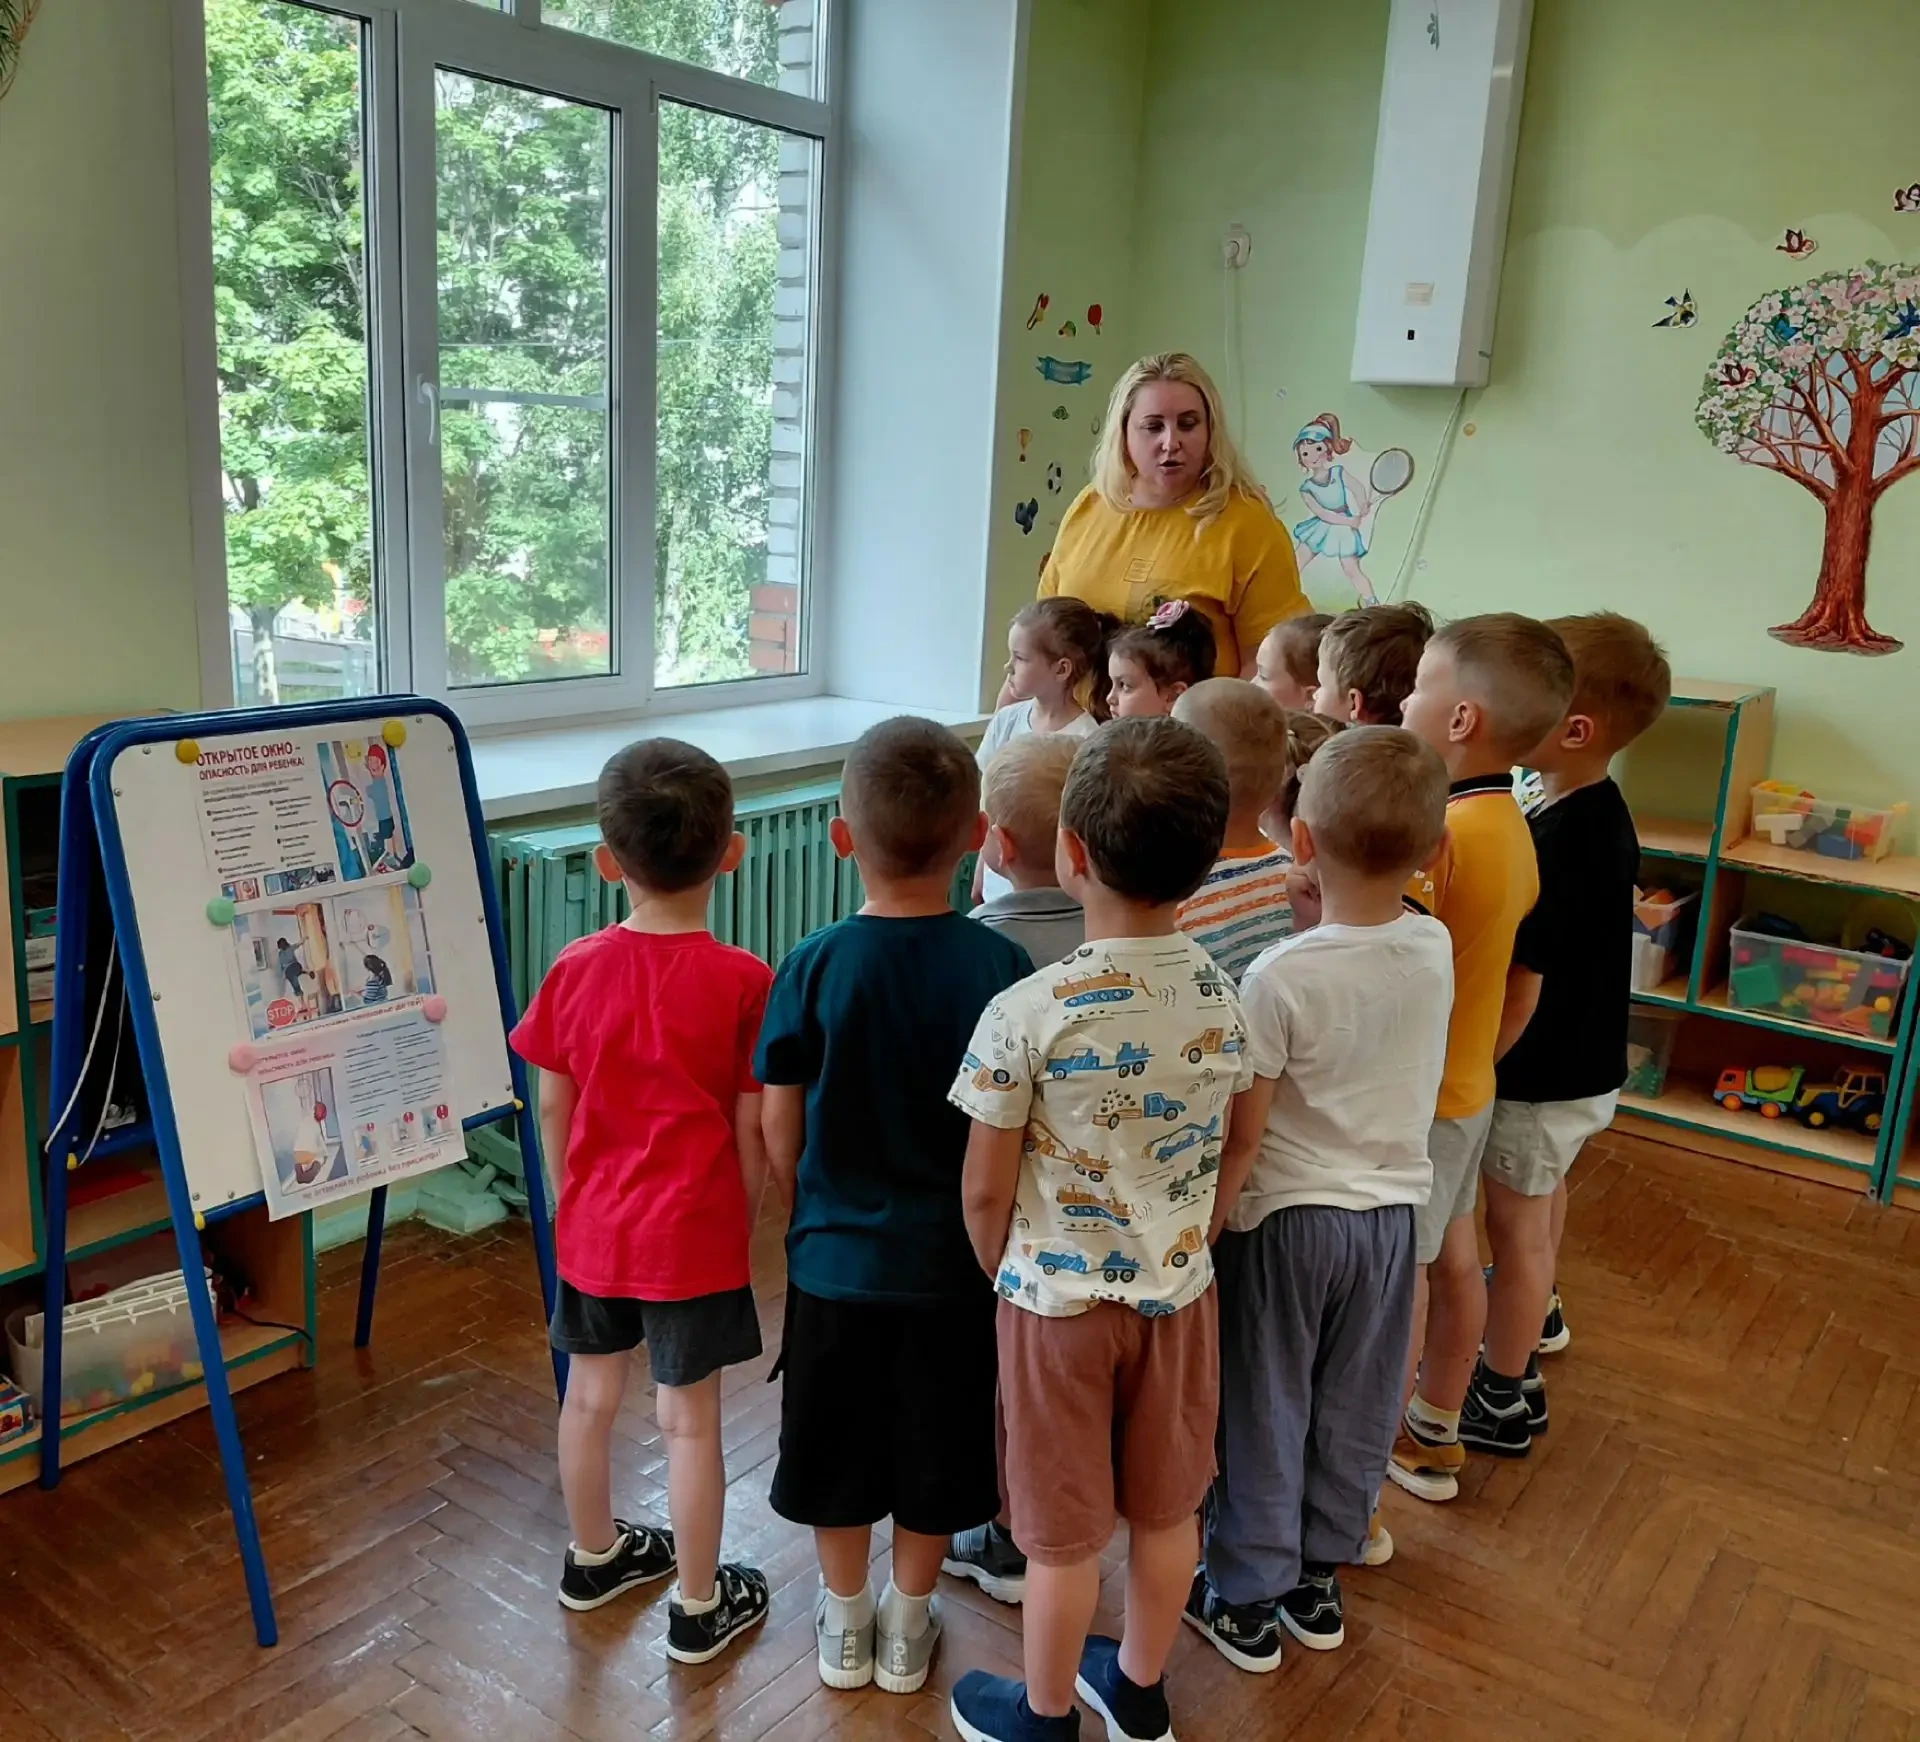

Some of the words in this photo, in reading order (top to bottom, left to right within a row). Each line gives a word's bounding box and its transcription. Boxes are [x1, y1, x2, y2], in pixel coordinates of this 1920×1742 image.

[196, 746, 259, 766] ОТКРЫТОЕ
[261, 742, 293, 758] ОКНО
[200, 765, 250, 780] ОПАСНОСТЬ
[251, 761, 268, 774] ДЛЯ
[267, 1004, 294, 1021] STOP
